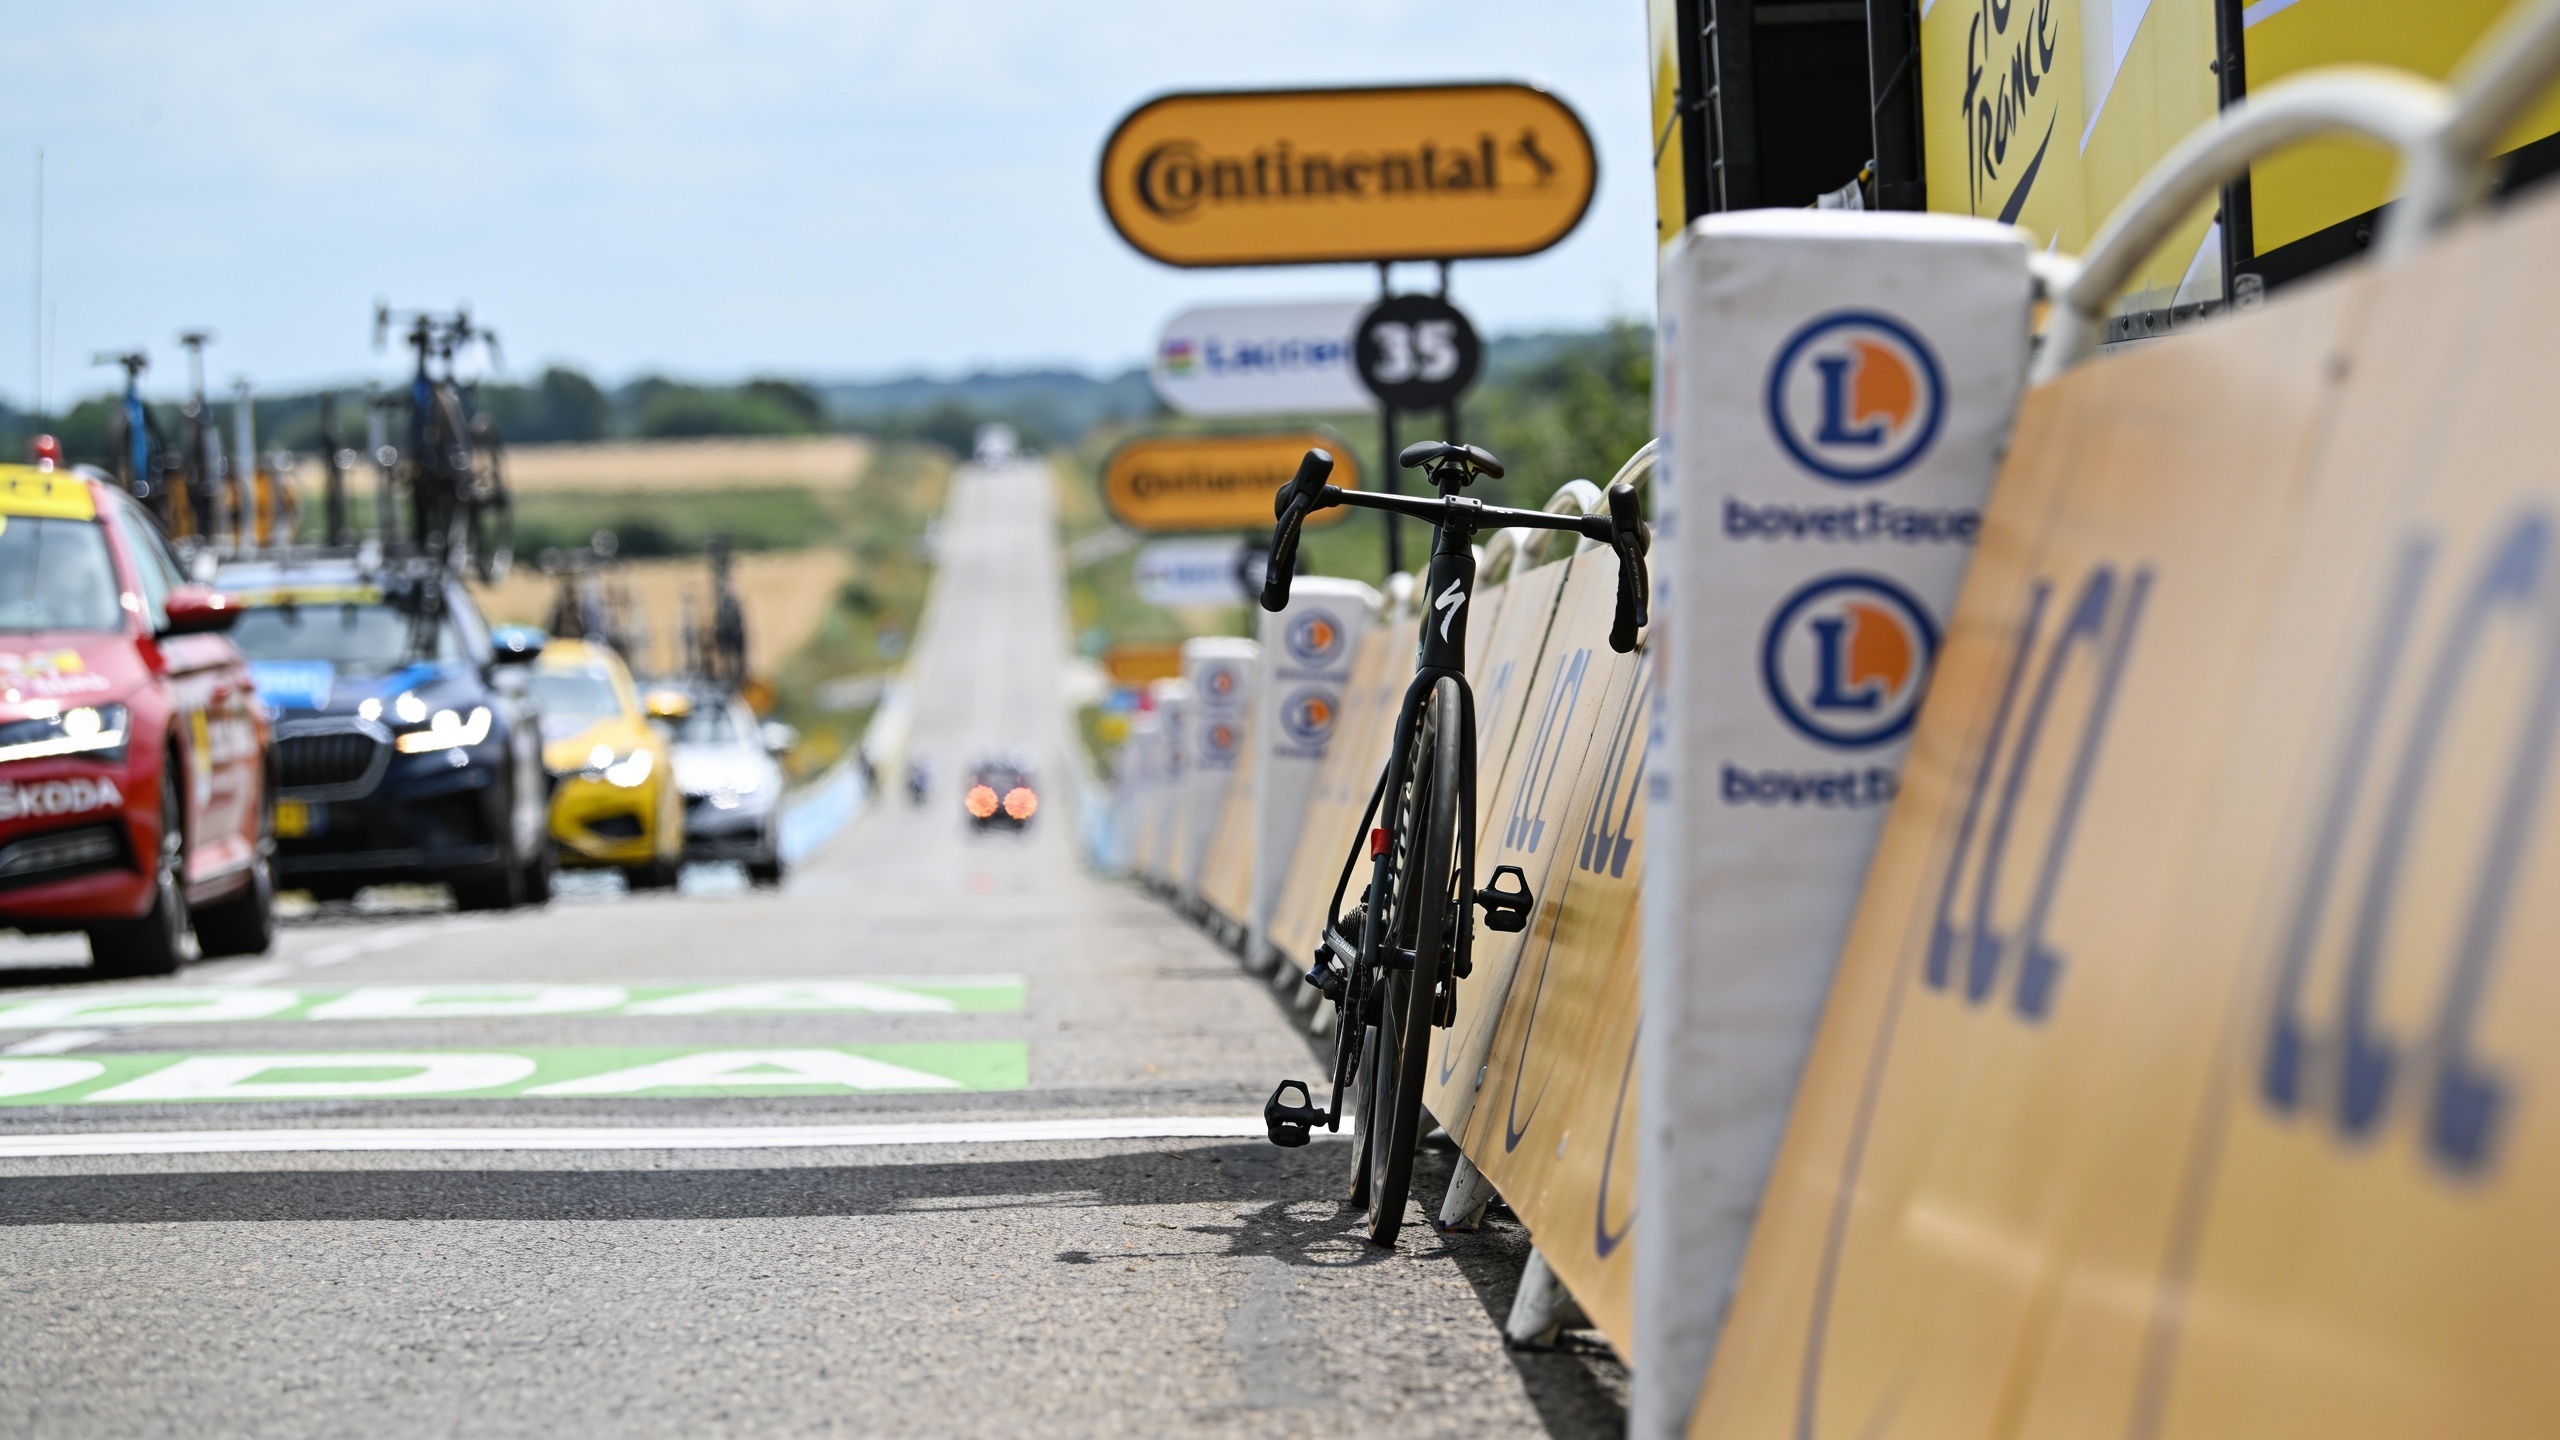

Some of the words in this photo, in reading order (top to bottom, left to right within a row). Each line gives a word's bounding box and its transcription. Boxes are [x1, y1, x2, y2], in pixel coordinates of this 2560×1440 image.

[1134, 133, 1496, 222] Continental
[1370, 319, 1462, 384] 35
[1506, 648, 1592, 854] LCL
